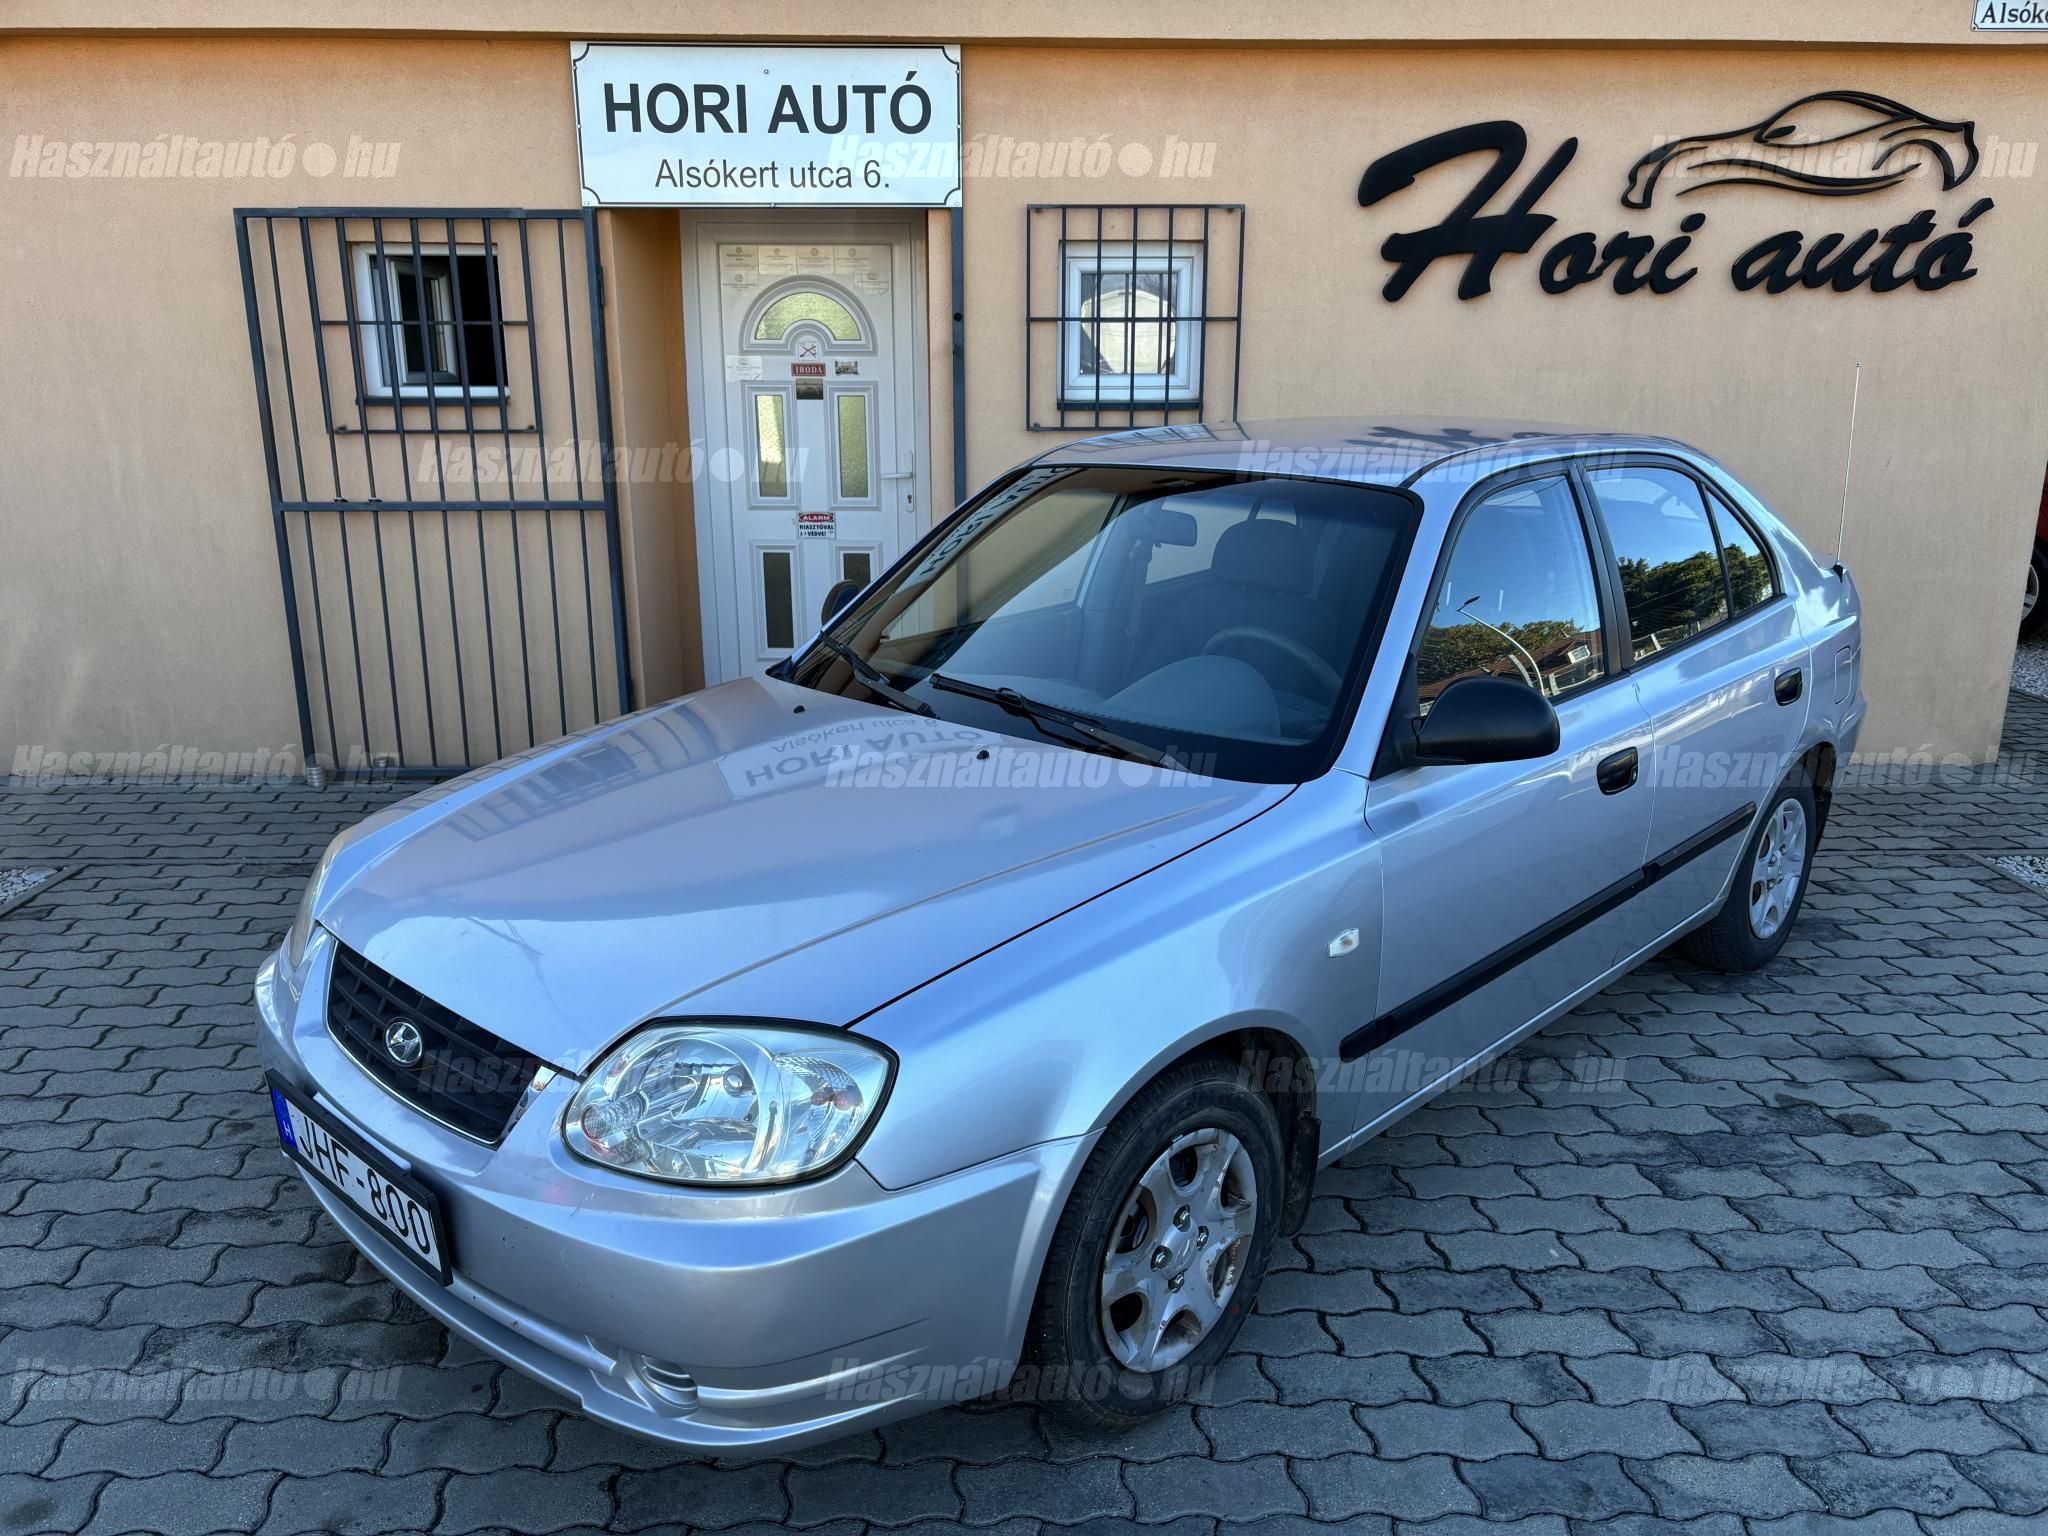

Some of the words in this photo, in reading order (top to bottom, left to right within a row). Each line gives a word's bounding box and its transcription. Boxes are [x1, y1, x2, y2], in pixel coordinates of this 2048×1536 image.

[603, 82, 748, 134] HORI
[767, 70, 932, 135] AUTÓ
[654, 158, 779, 189] Alsókert
[789, 161, 853, 189] utca
[862, 159, 890, 189] 6.
[1357, 119, 1706, 303] Hori
[1731, 197, 1995, 295] autó
[795, 366, 823, 374] IRODA
[299, 1116, 431, 1255] JHF-800
